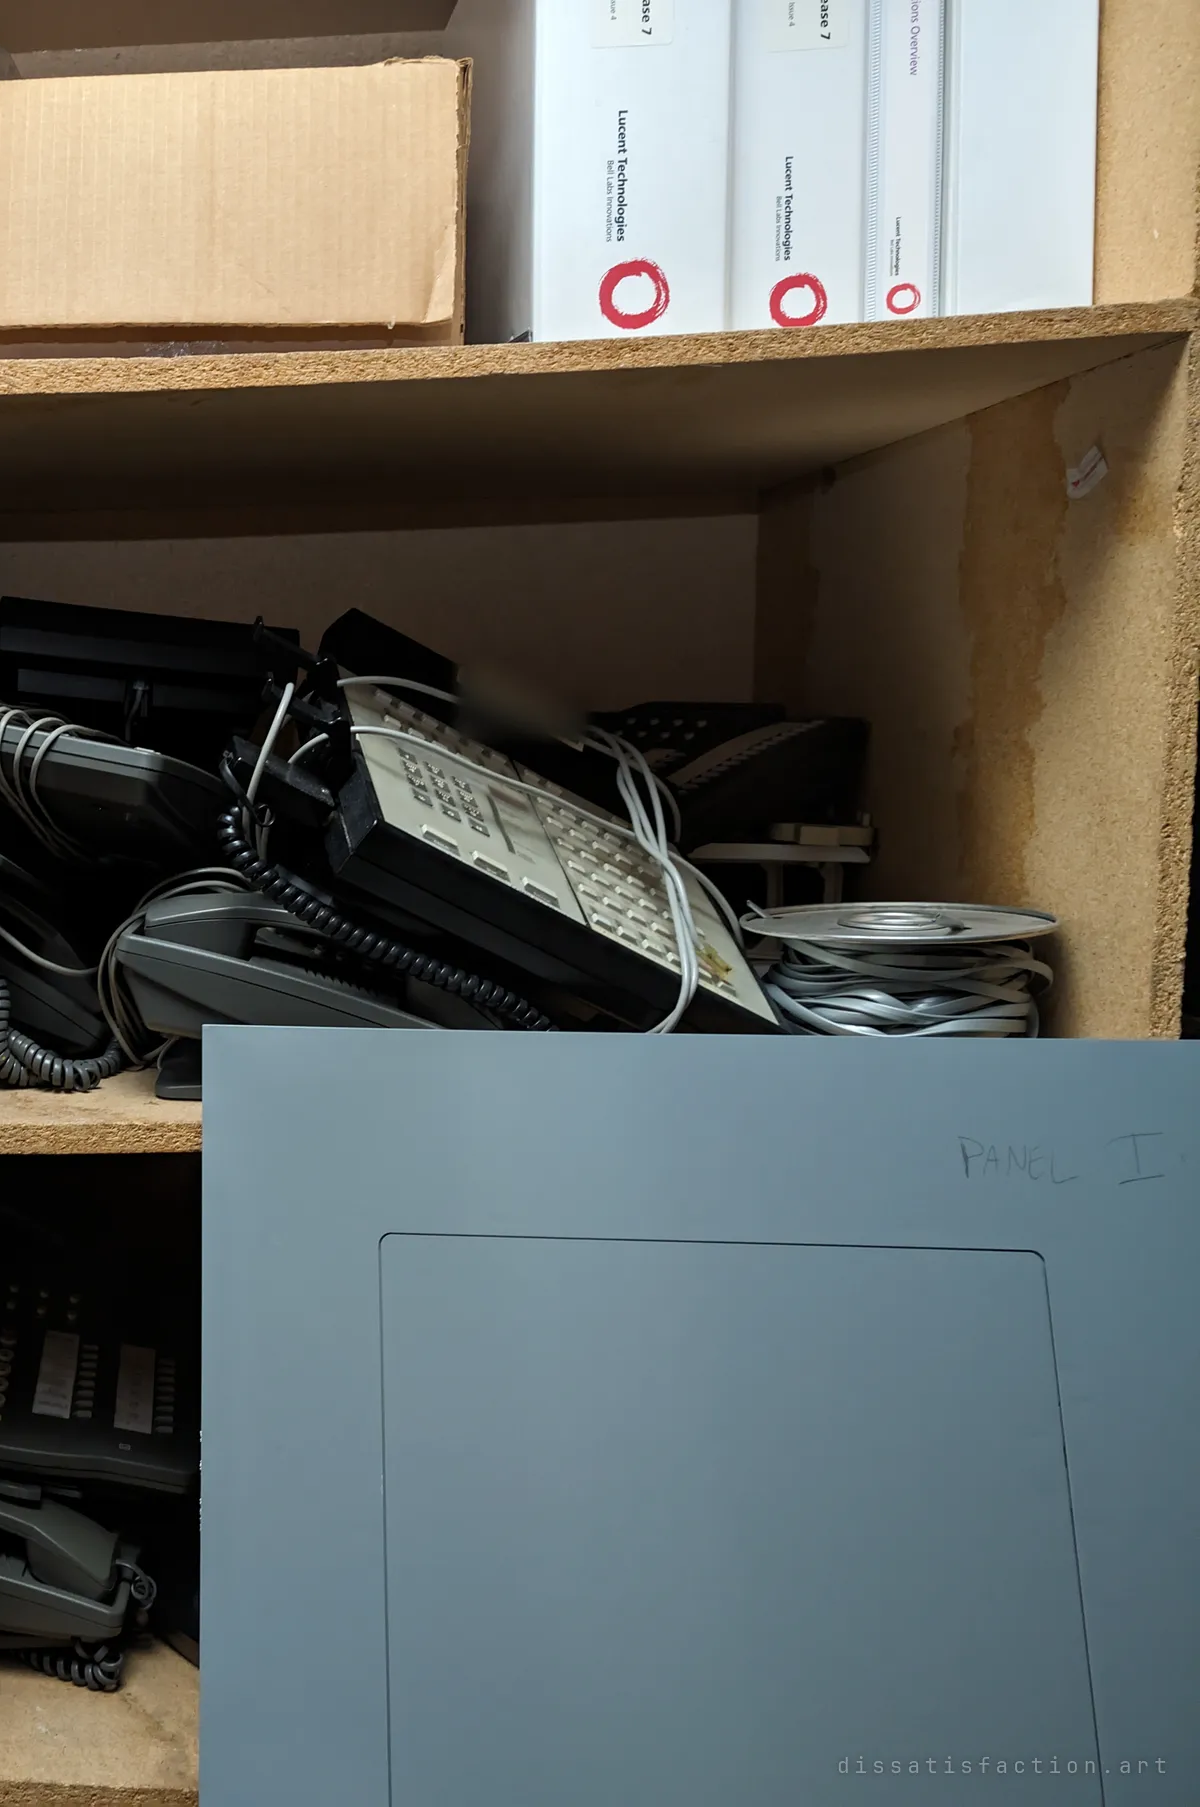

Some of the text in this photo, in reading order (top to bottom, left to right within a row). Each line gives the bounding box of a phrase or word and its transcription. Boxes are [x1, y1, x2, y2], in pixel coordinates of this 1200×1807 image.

[641, 27, 653, 35] 7
[820, 32, 831, 40] 7
[909, 26, 921, 76] Overview
[606, 177, 614, 195] Labs
[614, 110, 628, 242] Lucent Technologies
[606, 197, 614, 242] Innovations
[782, 156, 794, 261] Lucent Technologies
[958, 1136, 1079, 1184] PANEL
